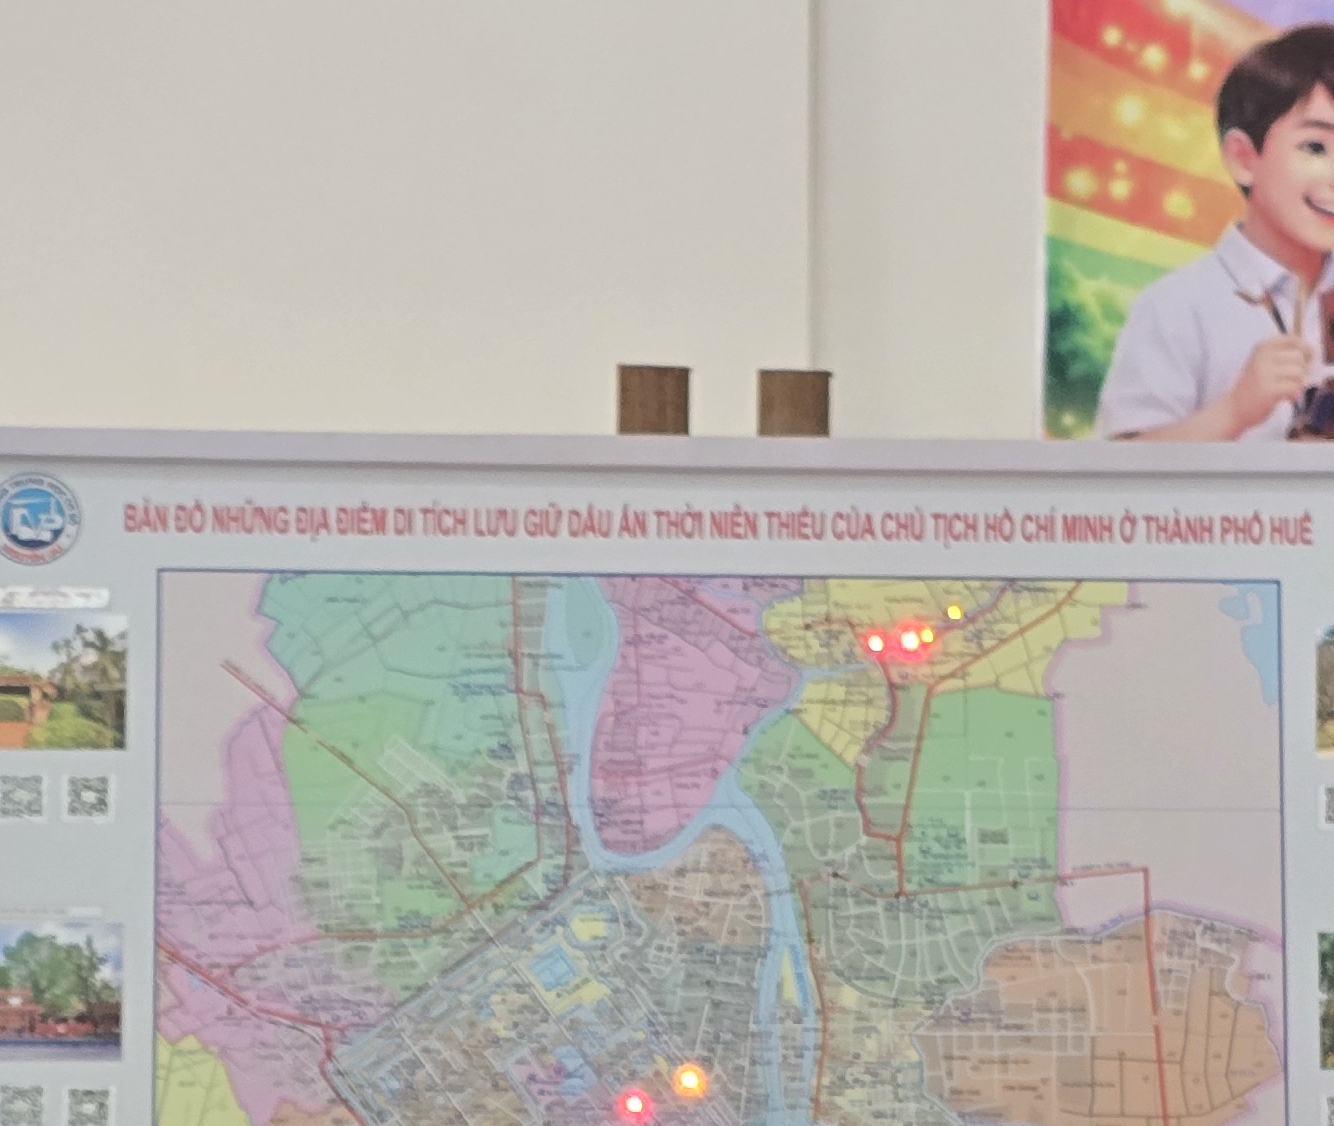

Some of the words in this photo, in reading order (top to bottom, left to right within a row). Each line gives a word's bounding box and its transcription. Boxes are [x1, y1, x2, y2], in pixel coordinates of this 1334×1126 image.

[124, 497, 167, 533] BẢN
[174, 499, 206, 534] ĐỒ
[295, 506, 331, 542] ĐỊA
[392, 506, 414, 536] DI
[420, 499, 467, 537] TÍCH
[473, 508, 517, 537] LƯU
[654, 502, 705, 539] THỜI
[709, 502, 759, 540] NIÊN
[831, 505, 875, 541] CỦA
[881, 507, 925, 542] CHỦ
[930, 512, 979, 549] TỊCH
[1021, 507, 1057, 543] CHÍ
[1062, 514, 1114, 544] MINH
[1142, 508, 1214, 544] THÀNH
